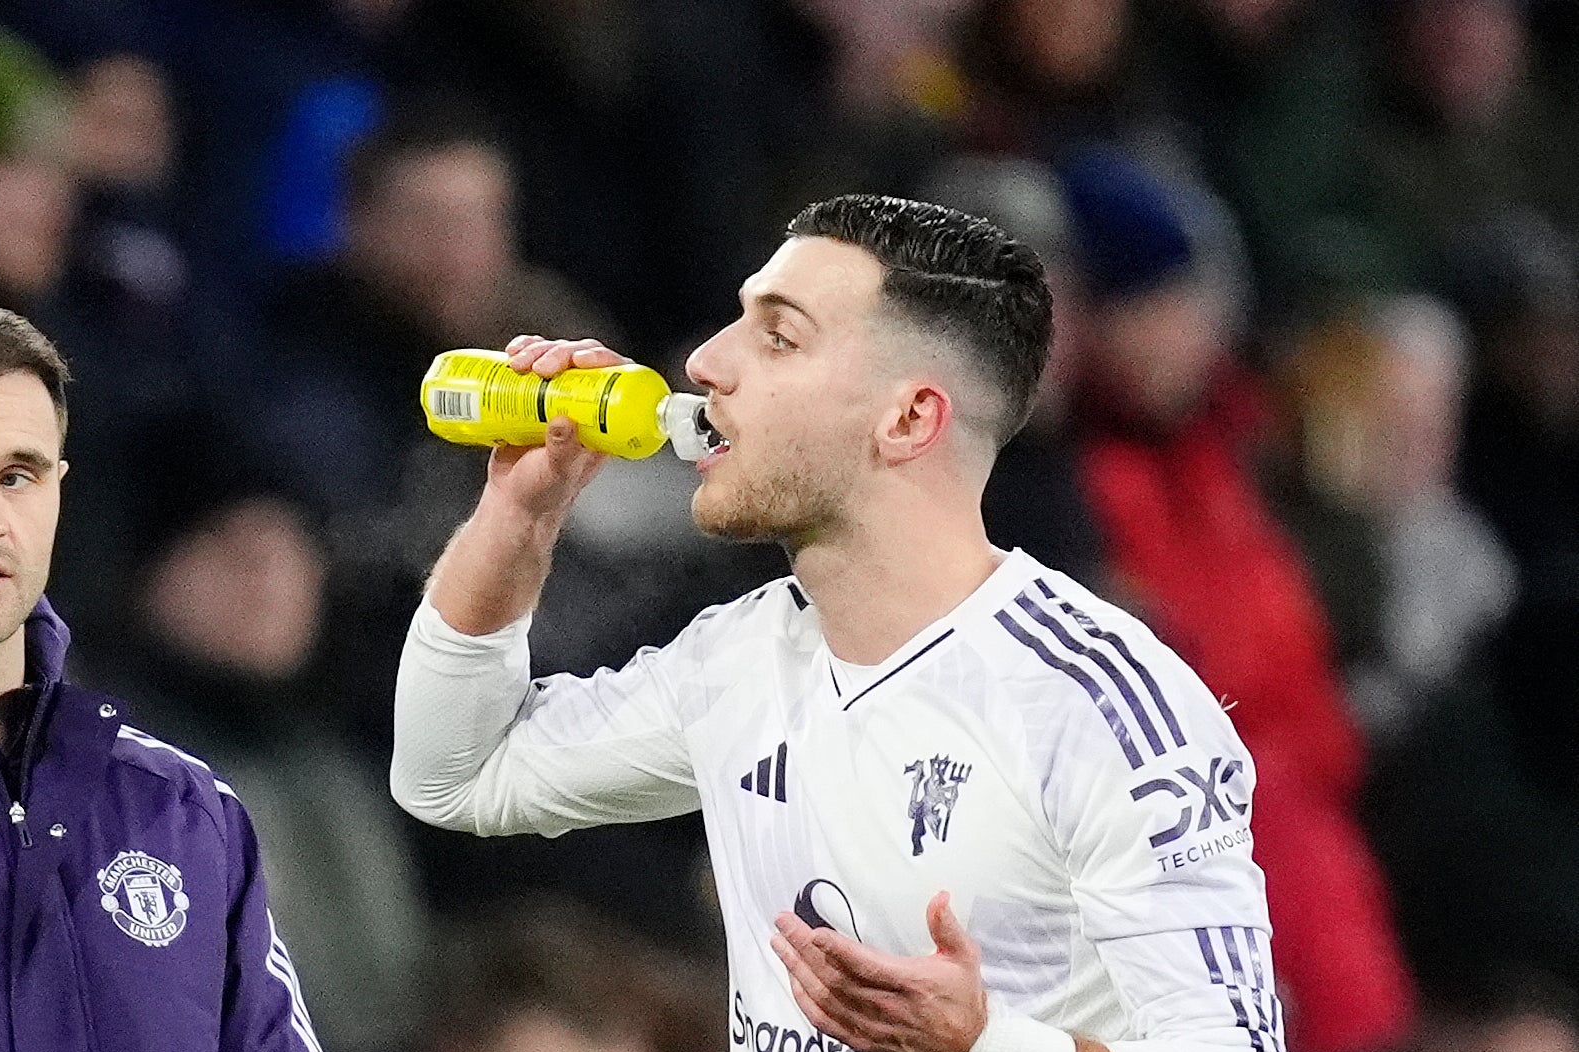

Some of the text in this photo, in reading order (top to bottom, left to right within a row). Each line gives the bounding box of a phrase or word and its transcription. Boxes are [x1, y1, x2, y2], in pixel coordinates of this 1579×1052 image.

[1130, 757, 1248, 848] DXC
[1157, 827, 1252, 872] TECHNOLOG
[105, 857, 176, 889] MANCHESTER
[129, 922, 177, 940] UNITED
